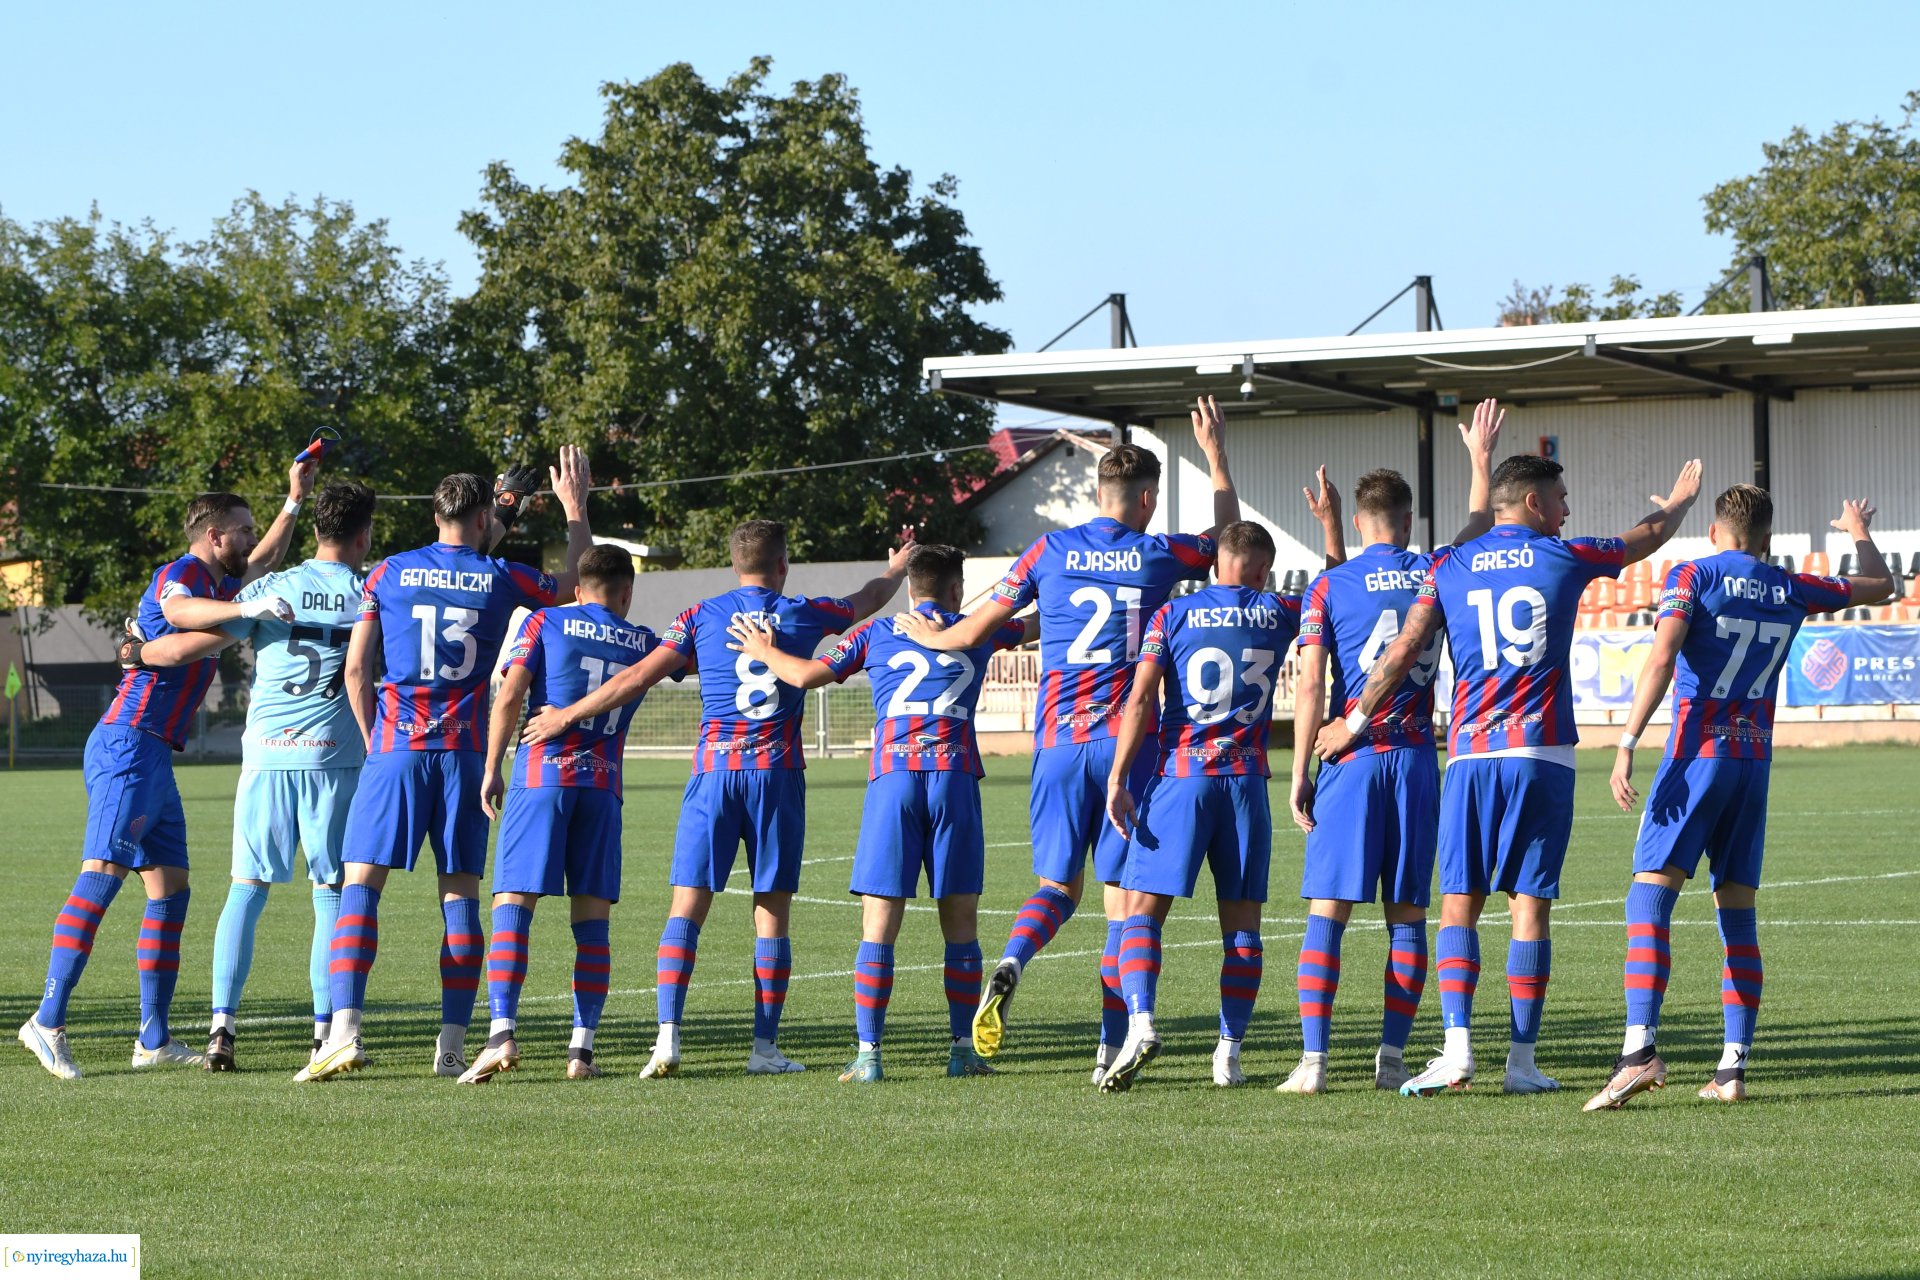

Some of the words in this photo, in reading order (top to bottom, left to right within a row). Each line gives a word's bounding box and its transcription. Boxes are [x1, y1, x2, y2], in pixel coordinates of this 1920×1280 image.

[1066, 547, 1141, 571] RJASKÓ
[1472, 543, 1534, 572] GRESÓ
[400, 568, 492, 592] GENGELICZKI
[1724, 577, 1767, 602] NAGY
[302, 592, 345, 612] DALA
[564, 619, 646, 652] HERJECZKI
[1067, 587, 1141, 663] 21
[1467, 586, 1547, 670] 19
[412, 605, 479, 680] 13
[1710, 615, 1791, 699] 77
[282, 626, 352, 700] 57
[1854, 656, 1920, 671] PRES
[1855, 673, 1912, 681] MEDICAL
[580, 656, 630, 735] 17
[736, 651, 780, 719] 8
[887, 650, 975, 720] 22
[1187, 647, 1275, 724] 93
[260, 739, 298, 747] LERTON
[302, 740, 337, 748] TRANS
[885, 744, 931, 753] LERTON
